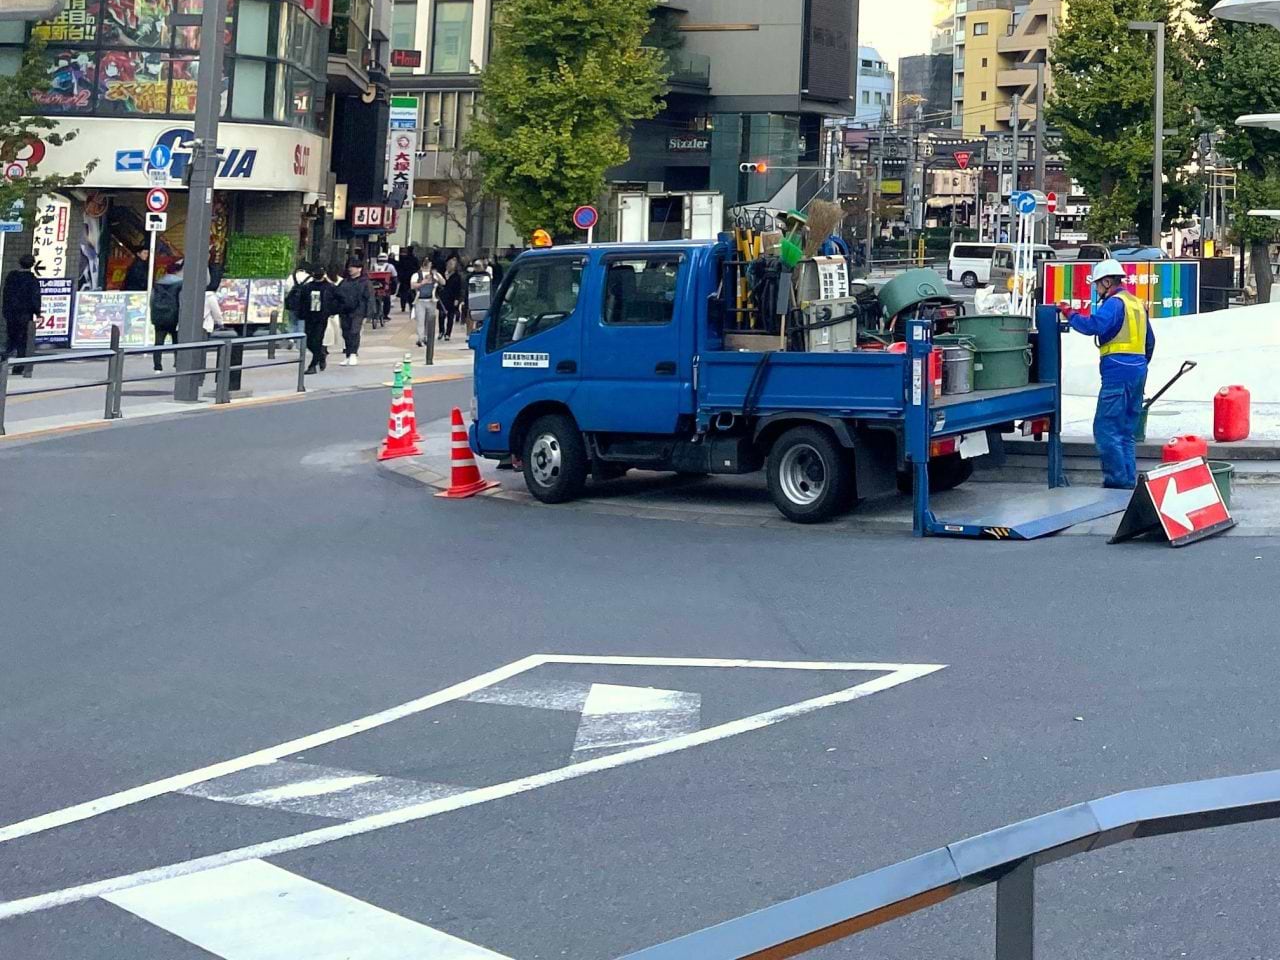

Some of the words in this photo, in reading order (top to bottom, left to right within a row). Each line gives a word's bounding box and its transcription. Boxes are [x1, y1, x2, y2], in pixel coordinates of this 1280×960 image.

[147, 128, 258, 178] GIA
[668, 138, 709, 150] Sizzler
[42, 204, 56, 246] カセル
